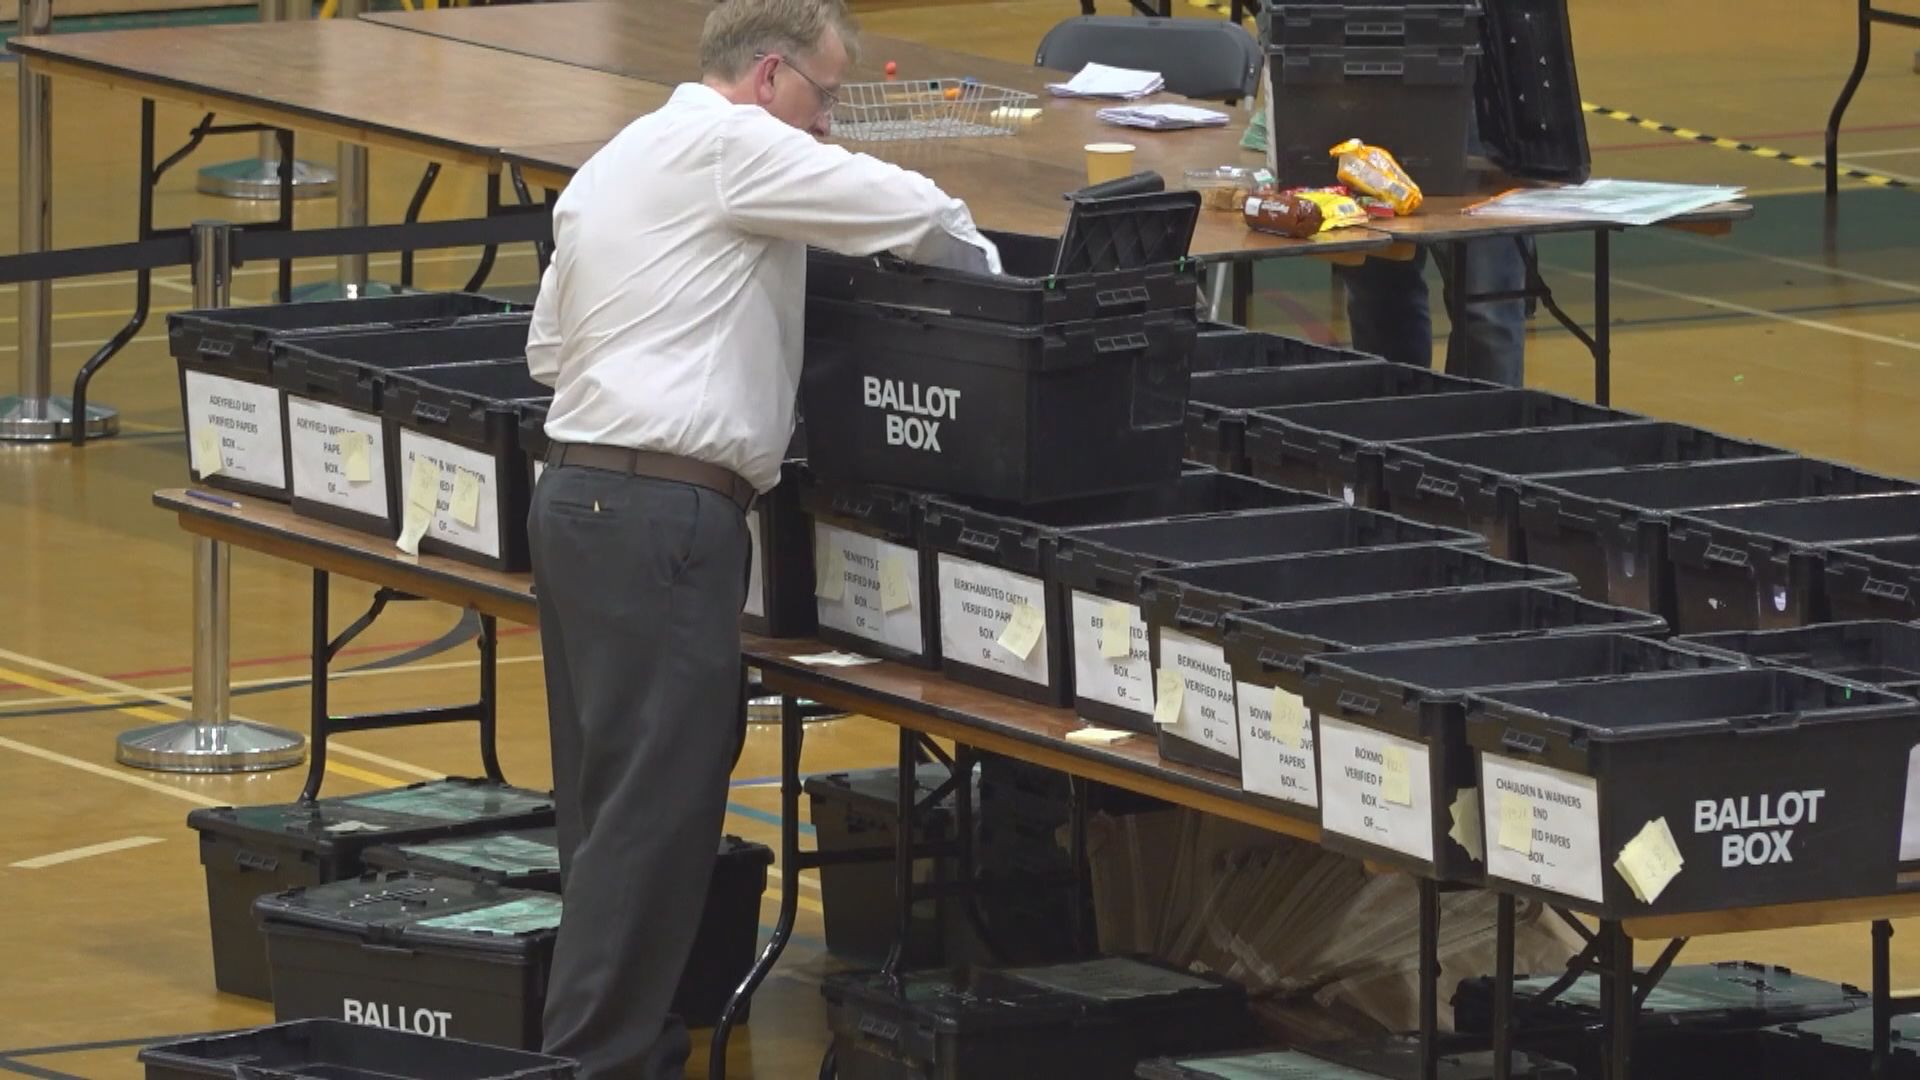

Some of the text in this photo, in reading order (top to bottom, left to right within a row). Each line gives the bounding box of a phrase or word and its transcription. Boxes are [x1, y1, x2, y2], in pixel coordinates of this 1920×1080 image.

[209, 394, 256, 413] ADEYFIELD EAST
[864, 376, 961, 420] BALLOT
[208, 414, 258, 435] VERIFIED PAPERS
[296, 416, 327, 433] ADEYFIELD
[886, 414, 941, 453] BOX
[222, 436, 235, 448] BOX
[323, 442, 341, 455] PAPE
[226, 457, 234, 467] OF
[324, 462, 339, 473] BOX
[328, 482, 336, 493] OF
[439, 520, 447, 531] OF
[843, 571, 867, 588] ERIFIED
[954, 577, 1005, 601] BERKHAMSTED
[854, 595, 867, 608] BOX
[961, 601, 1012, 623] VERIFIED PAP
[856, 616, 865, 627] OF
[979, 626, 994, 640] BOX
[982, 648, 992, 659] OF
[1129, 648, 1147, 661] PAPE
[1113, 664, 1128, 677] BOX
[1177, 654, 1232, 681] BERKHAMSTED
[1117, 686, 1127, 697] OF
[1185, 678, 1232, 704] VERIFIED PAP
[1201, 706, 1216, 720] BOX
[1249, 706, 1272, 721] BOVIN
[1203, 728, 1214, 739] OF
[1250, 726, 1256, 737] &
[1280, 753, 1306, 769] PAPERS
[1355, 746, 1384, 765] BOXMO
[1281, 774, 1297, 788] BOX
[1344, 766, 1377, 785] VERIFIED
[1361, 792, 1377, 807] BOX
[1496, 777, 1582, 810] CHAULDEN & WARNERS
[1533, 806, 1548, 820] END
[1694, 789, 1825, 833] BALLOT
[1364, 816, 1374, 828] OF
[1545, 832, 1571, 849] PAPERS
[1528, 848, 1545, 864] BOX
[1721, 830, 1794, 868] BOX
[1531, 874, 1541, 885] OF
[343, 998, 452, 1038] BALLOT
